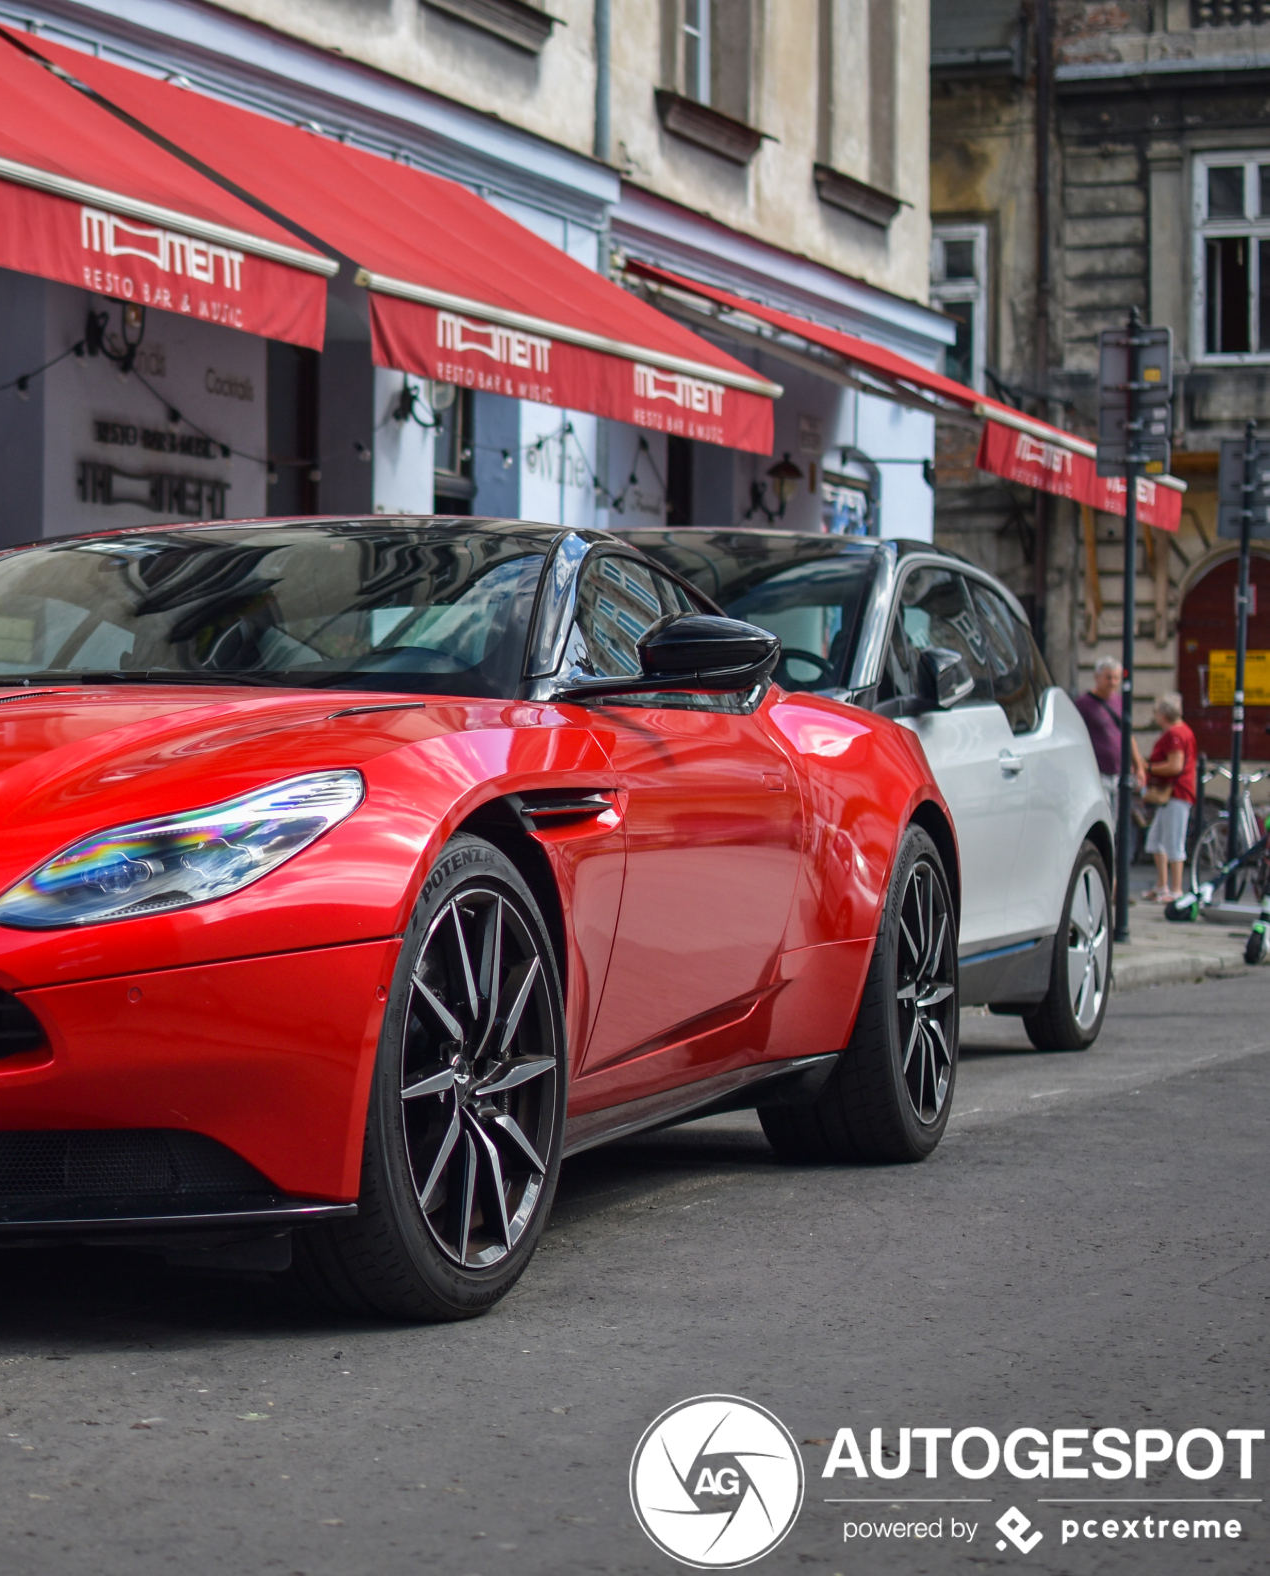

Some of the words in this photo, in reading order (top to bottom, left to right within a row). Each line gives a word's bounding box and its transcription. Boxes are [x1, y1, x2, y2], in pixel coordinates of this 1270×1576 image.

[81, 205, 245, 292] MOMENT
[83, 267, 134, 298] RESTO
[142, 282, 173, 308] BAR
[181, 294, 191, 313] &
[199, 300, 244, 328] MUSIC
[436, 310, 552, 374] MOMENT
[420, 848, 496, 905] POTENZA
